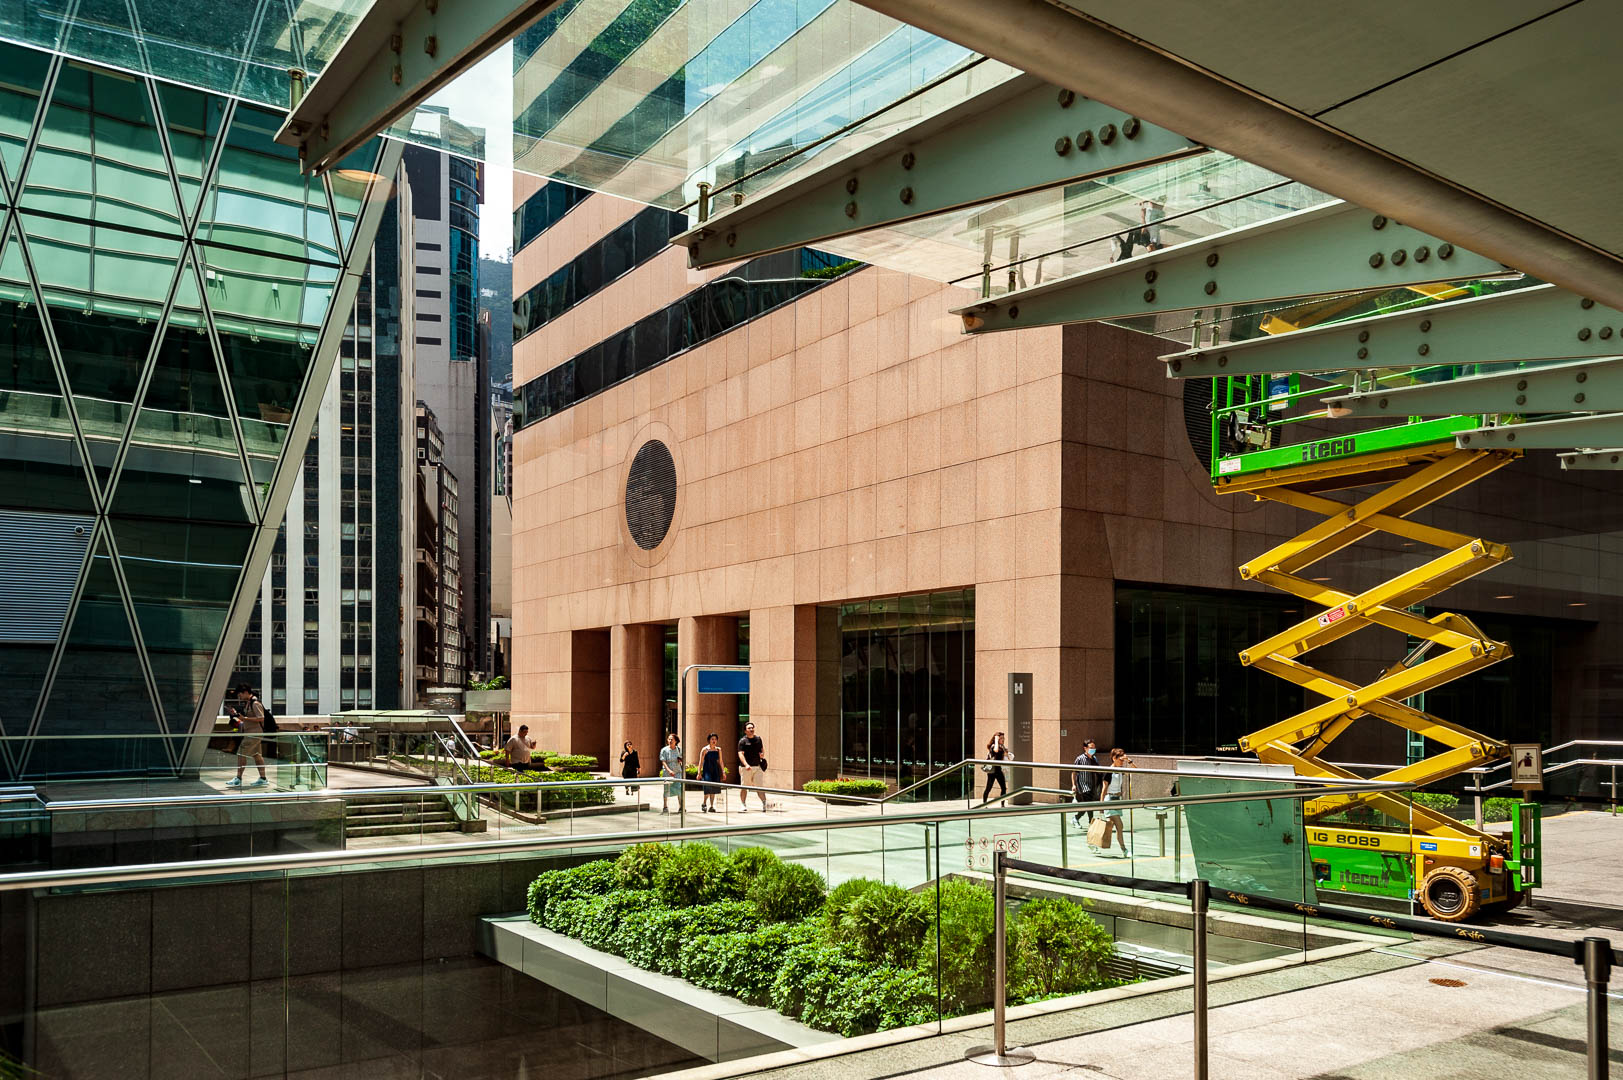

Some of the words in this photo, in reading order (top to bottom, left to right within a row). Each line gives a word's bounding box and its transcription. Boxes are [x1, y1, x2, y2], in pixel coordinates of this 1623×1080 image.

[1302, 438, 1355, 461] iteco
[1014, 682, 1023, 694] H
[1313, 832, 1329, 842] IG
[1336, 834, 1380, 847] 8089
[1339, 869, 1379, 887] iteco
